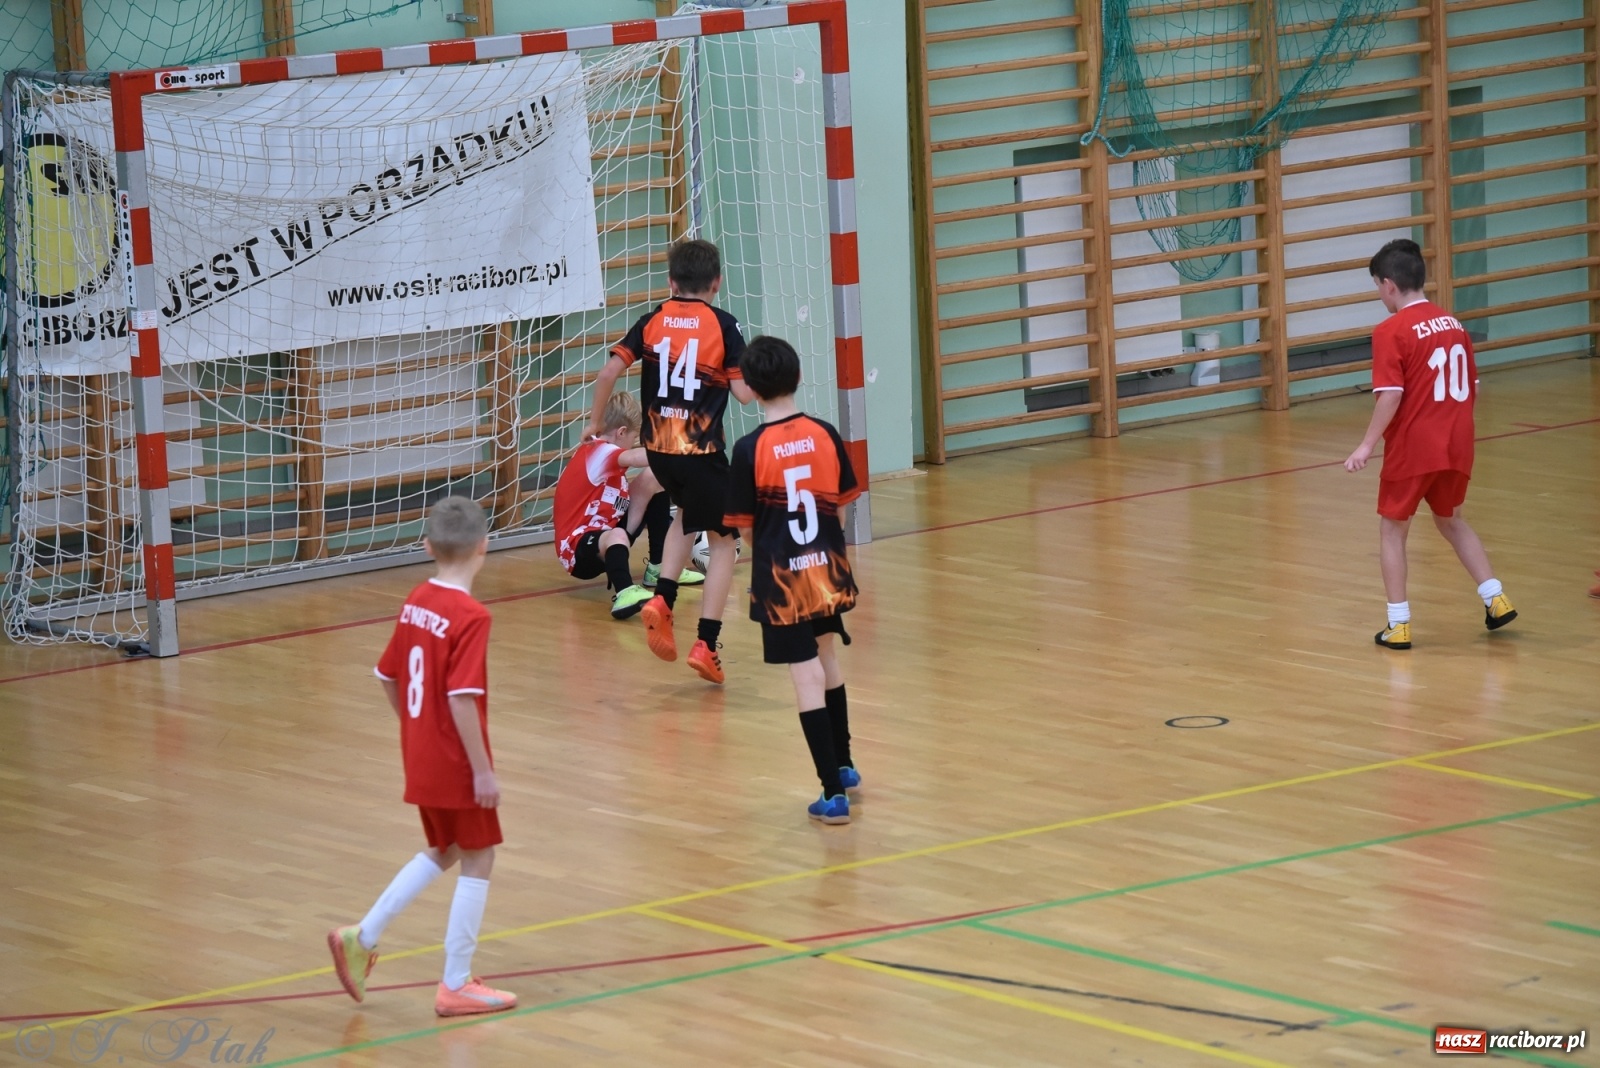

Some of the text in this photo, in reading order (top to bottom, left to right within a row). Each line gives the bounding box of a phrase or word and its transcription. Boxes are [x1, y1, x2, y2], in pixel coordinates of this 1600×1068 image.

[194, 69, 225, 84] sport
[161, 236, 261, 318] JEST
[270, 213, 313, 262] W
[328, 255, 567, 308] www.osir-raciborz.pl
[663, 315, 700, 329] PŁOMIEŃ
[1412, 321, 1431, 339] ZS
[653, 336, 701, 402] 14
[1427, 343, 1469, 402] 10
[773, 435, 815, 460] PŁOMIEŃ
[783, 464, 819, 545] 5
[407, 645, 424, 718] 8
